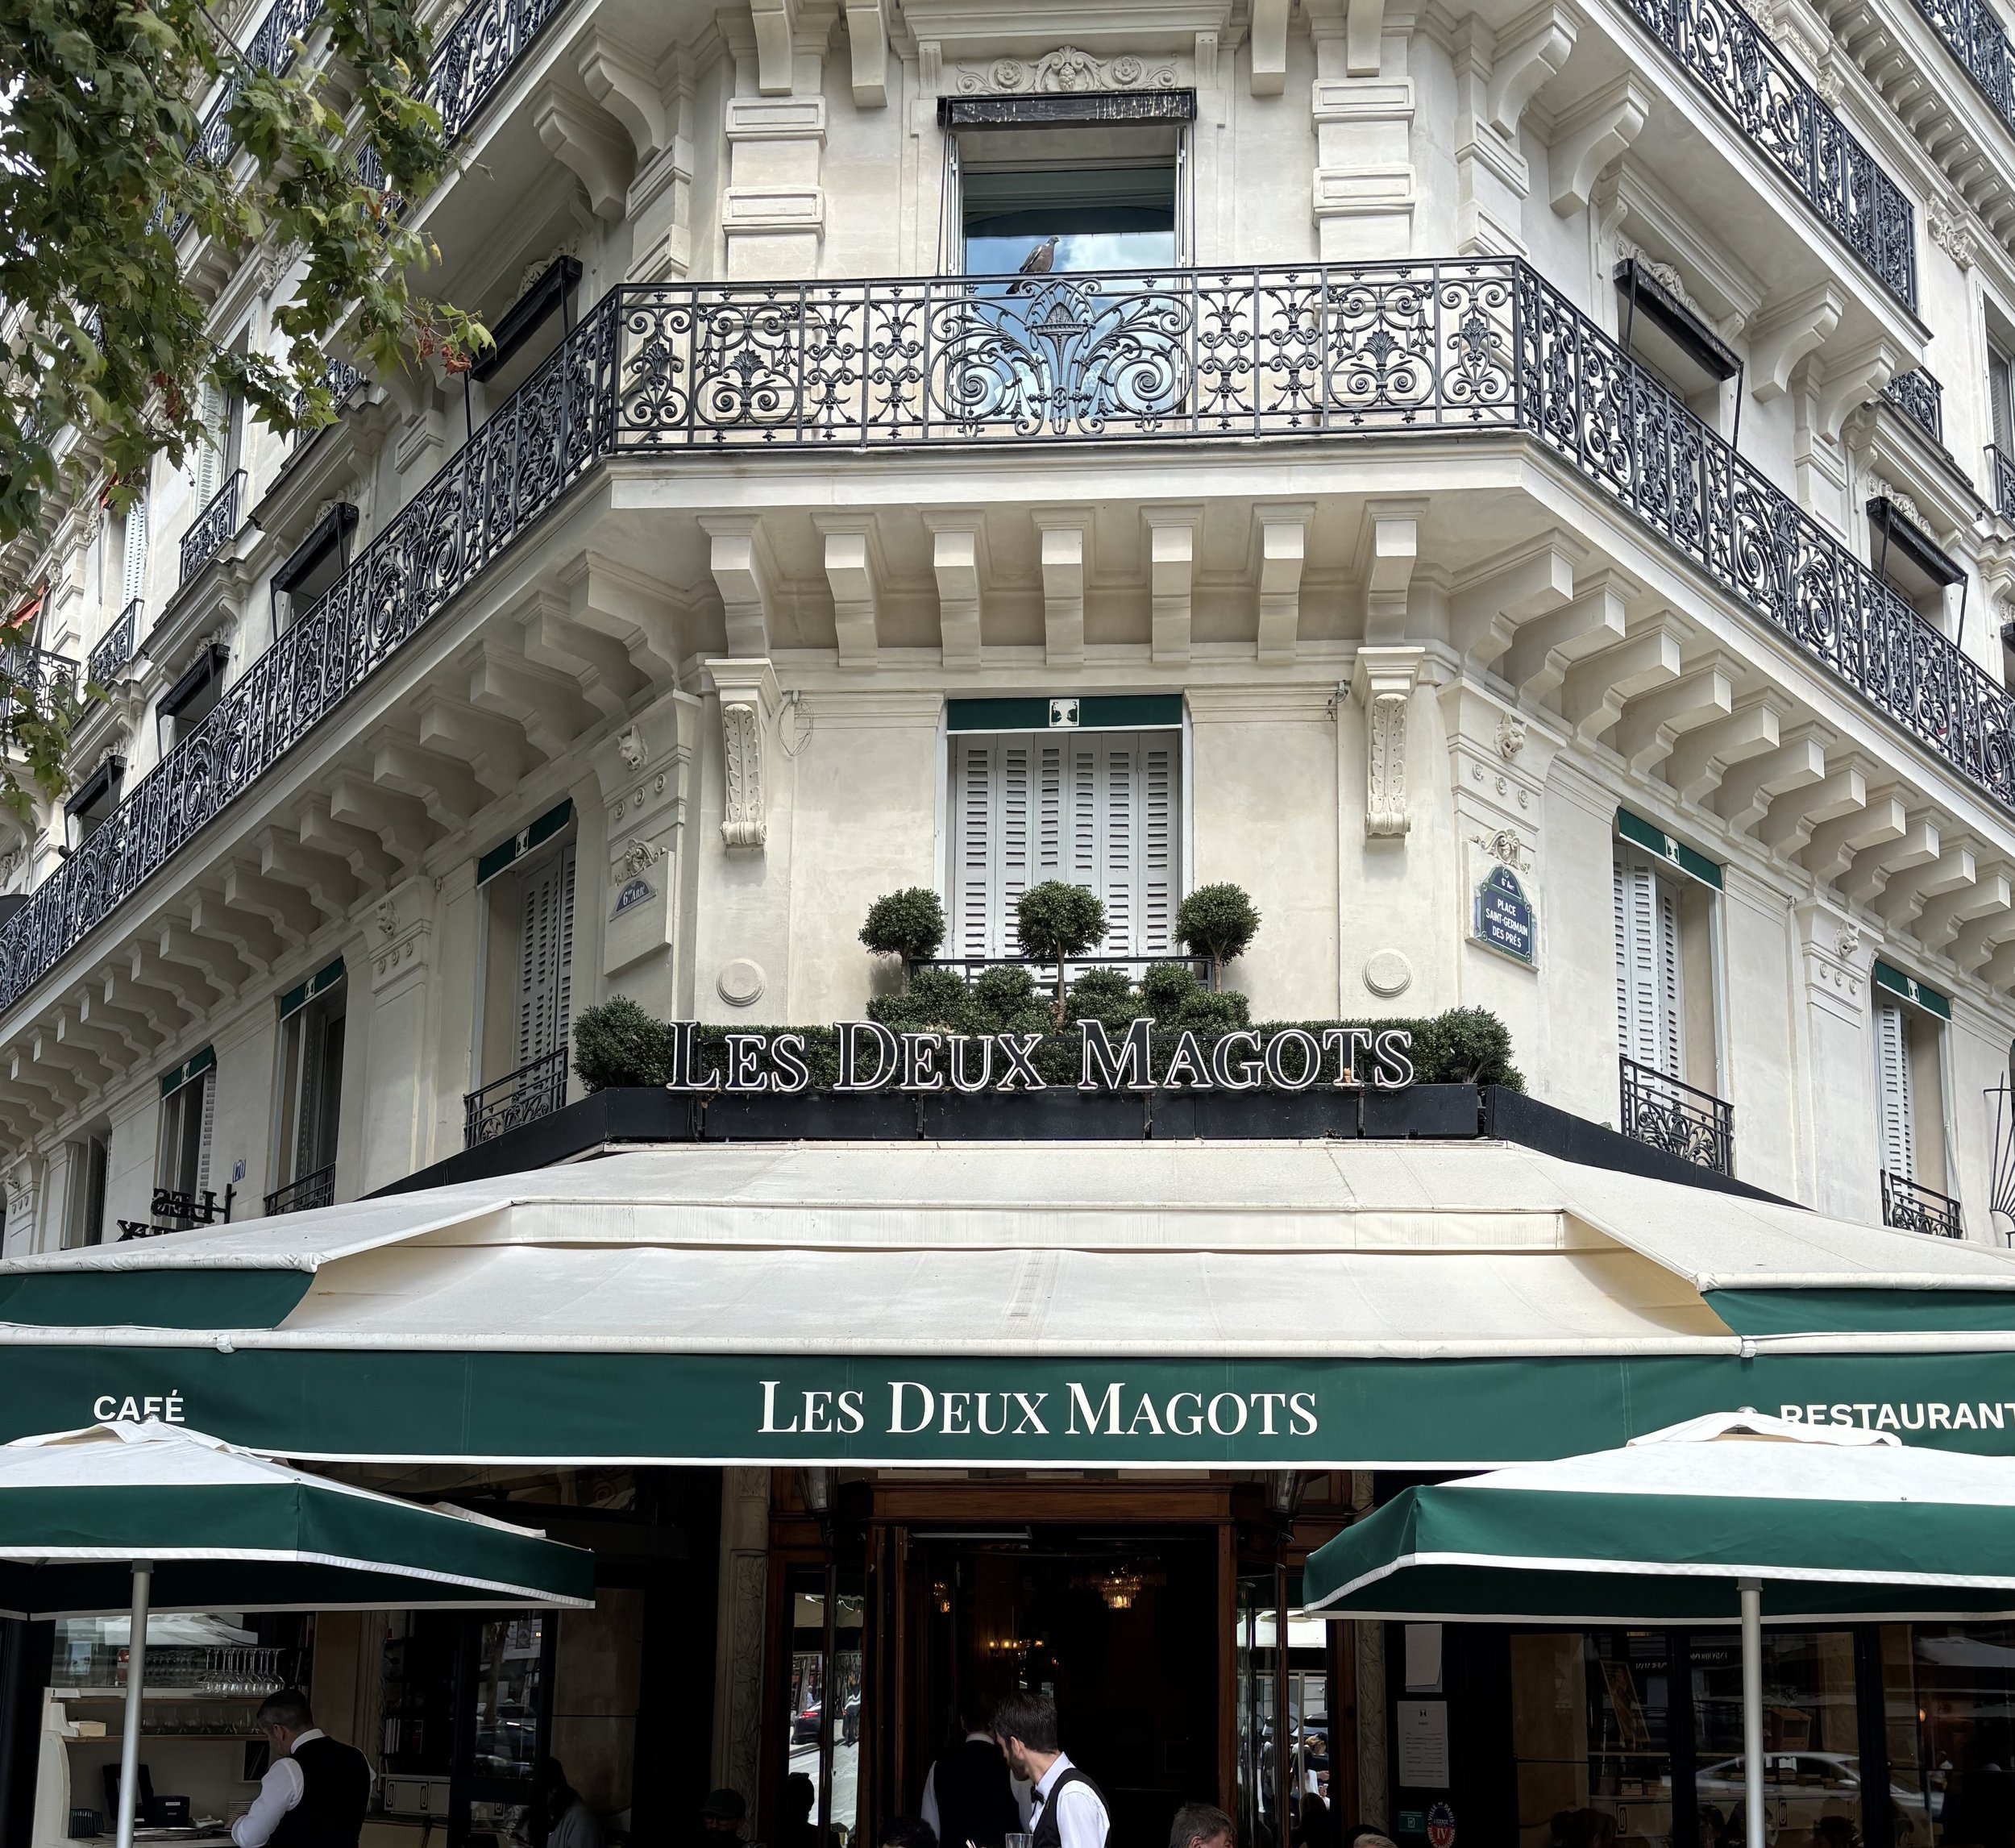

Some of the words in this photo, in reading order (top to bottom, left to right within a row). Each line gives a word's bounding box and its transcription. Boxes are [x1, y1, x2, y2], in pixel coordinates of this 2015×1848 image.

[1485, 907, 1528, 937] SAINT-GERMAIN
[1497, 898, 1517, 917] PLACE
[1492, 925, 1504, 940] DES
[1505, 932, 1522, 949] PRÉS
[666, 1020, 809, 1094] LES
[833, 1020, 1047, 1093] DEUX
[1076, 1018, 1415, 1090] MAGOTS
[93, 1389, 185, 1422] CAFÉ
[757, 1381, 864, 1434] LES
[886, 1381, 1050, 1435] DEUX
[1064, 1382, 1318, 1435] MAGOTS
